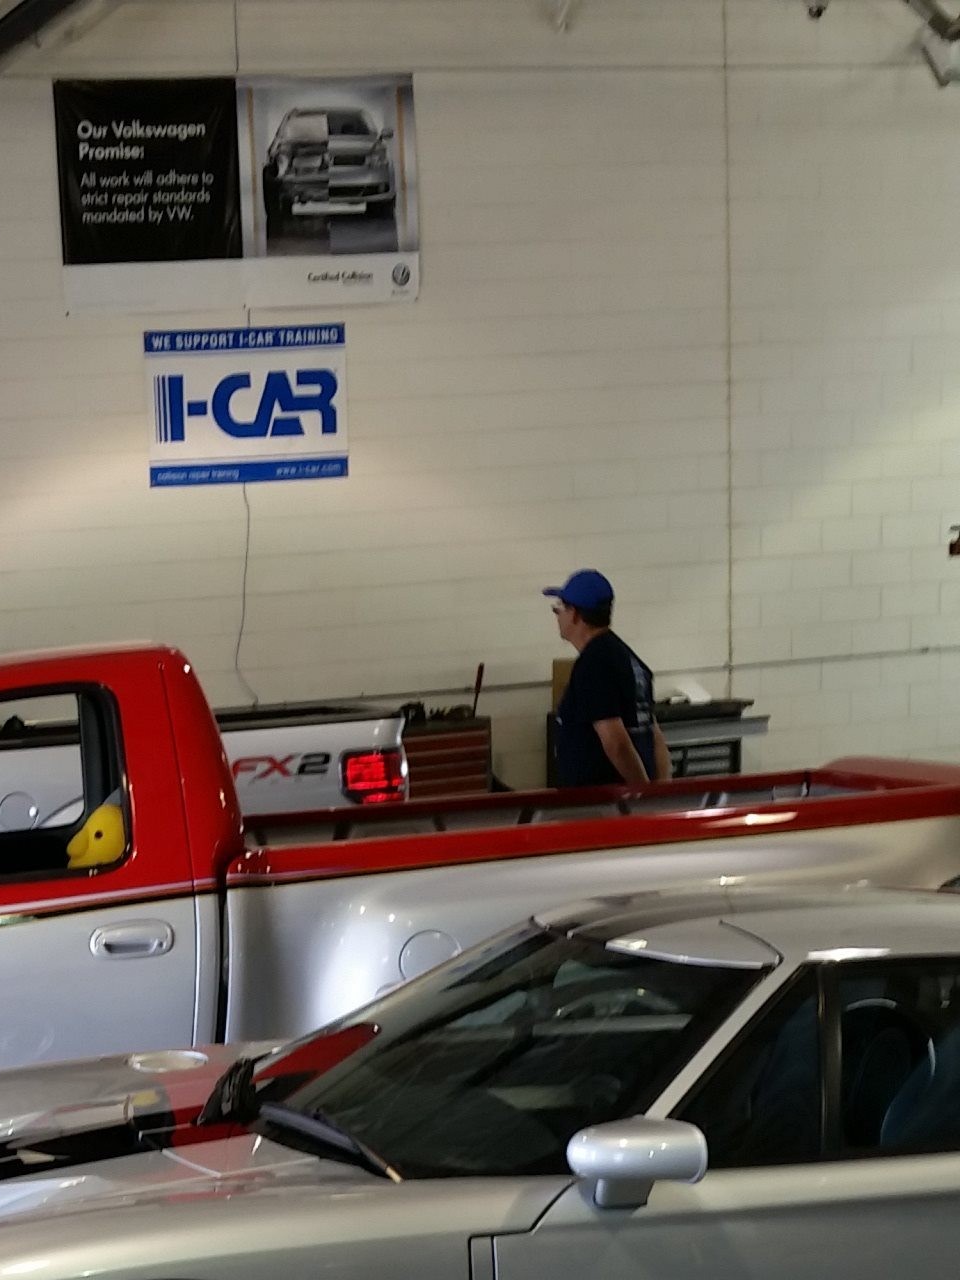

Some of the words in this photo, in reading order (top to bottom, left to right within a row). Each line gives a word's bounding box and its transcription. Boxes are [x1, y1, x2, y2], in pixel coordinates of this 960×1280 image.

[77, 119, 108, 140] Our
[111, 119, 206, 142] Volkswagen
[80, 171, 96, 187] All
[99, 170, 130, 187] work
[133, 170, 153, 187] will
[156, 169, 199, 186] adhere
[201, 170, 215, 186] to
[81, 190, 108, 207] strict
[112, 189, 149, 207] repair
[152, 187, 211, 204] standards
[82, 206, 145, 224] mandated
[148, 205, 164, 226] by
[151, 335, 172, 350] WE
[175, 332, 234, 349] SUPPORT
[238, 329, 275, 348] I-CAR
[278, 327, 339, 345] TRAINING
[153, 368, 339, 444] I-CAR
[233, 752, 331, 780] FX2
